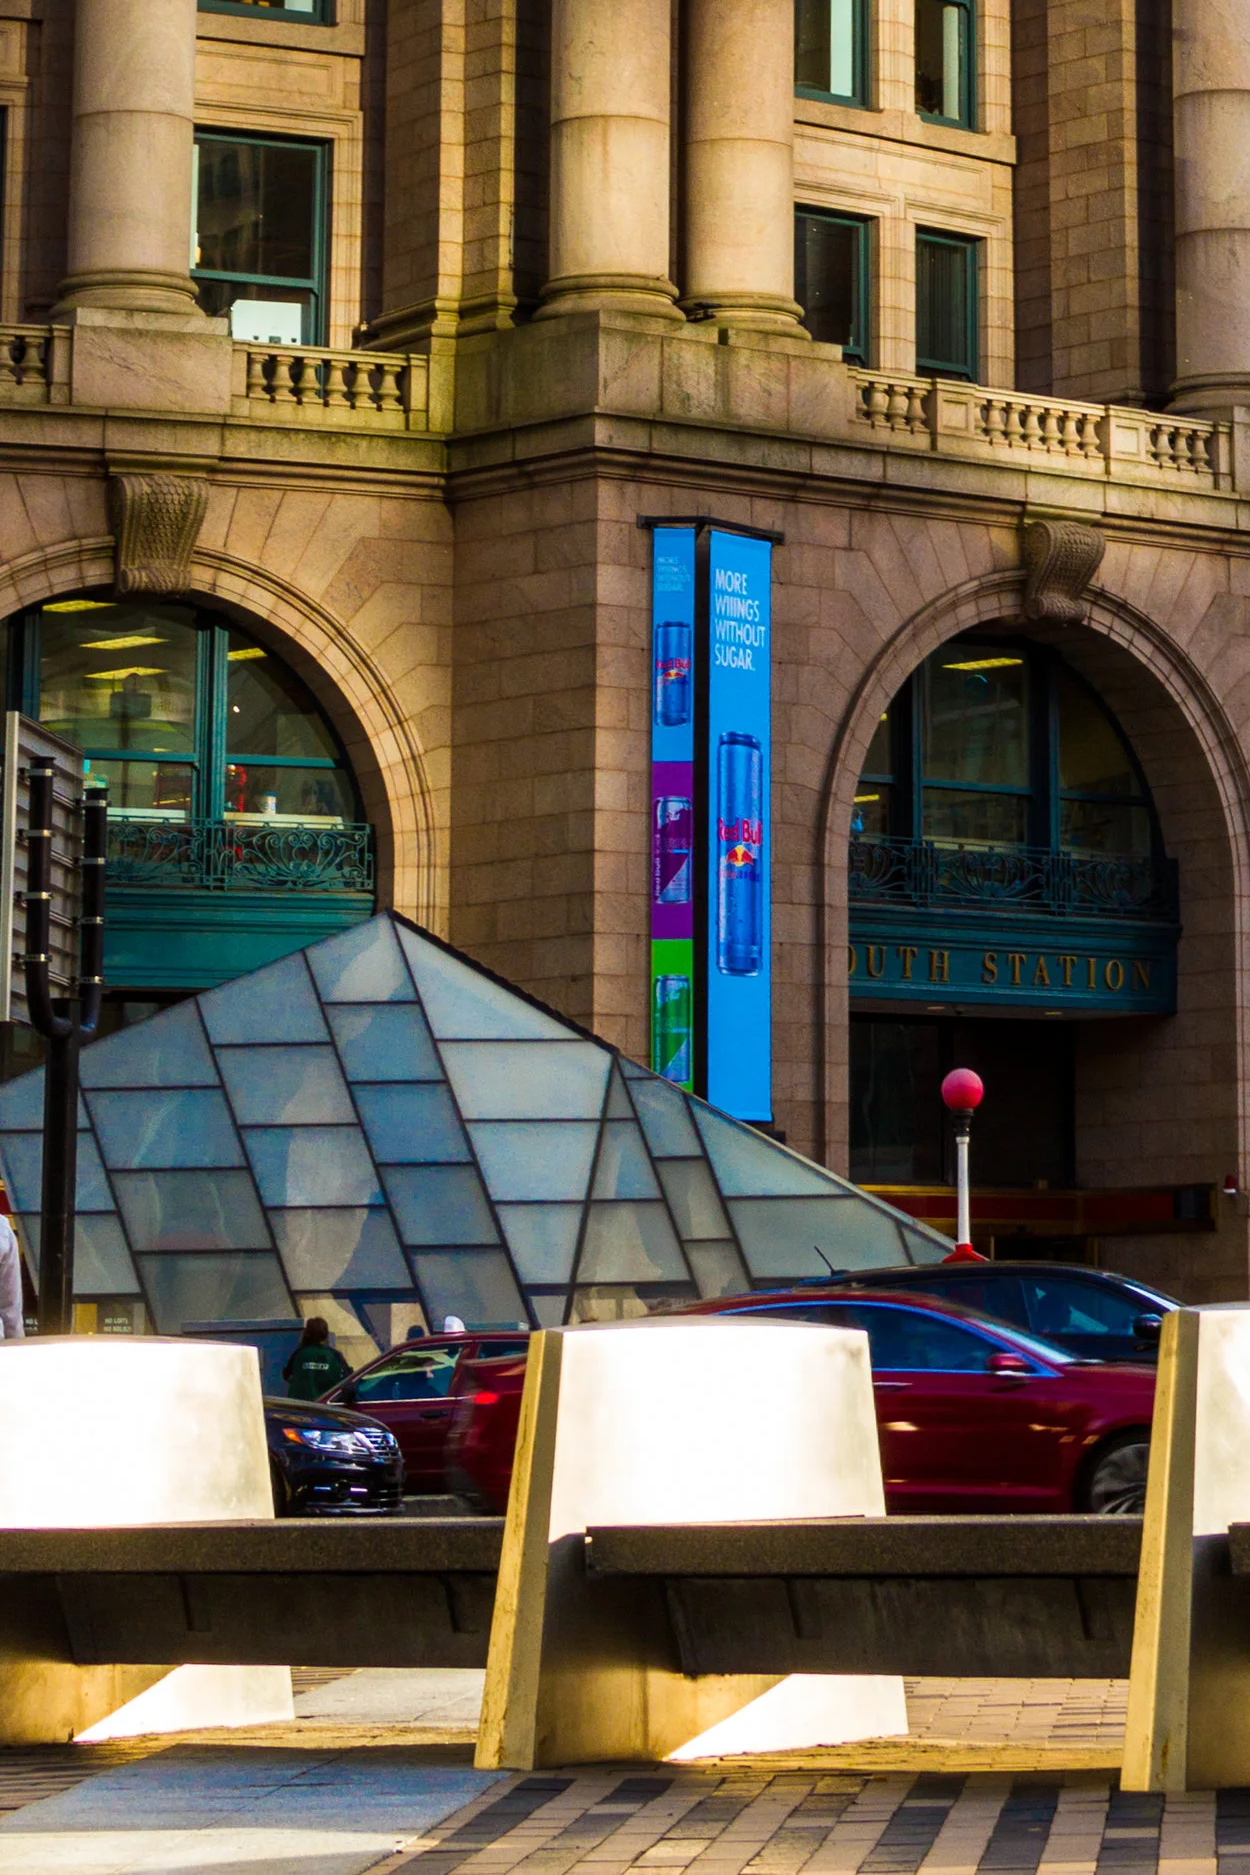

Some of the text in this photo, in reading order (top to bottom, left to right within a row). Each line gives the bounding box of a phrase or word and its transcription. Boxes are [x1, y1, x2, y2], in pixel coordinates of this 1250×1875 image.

[715, 568, 748, 596] MORE
[714, 618, 766, 649] WITHOUT
[718, 816, 763, 846] Red Bull
[981, 951, 1150, 991] STATION
